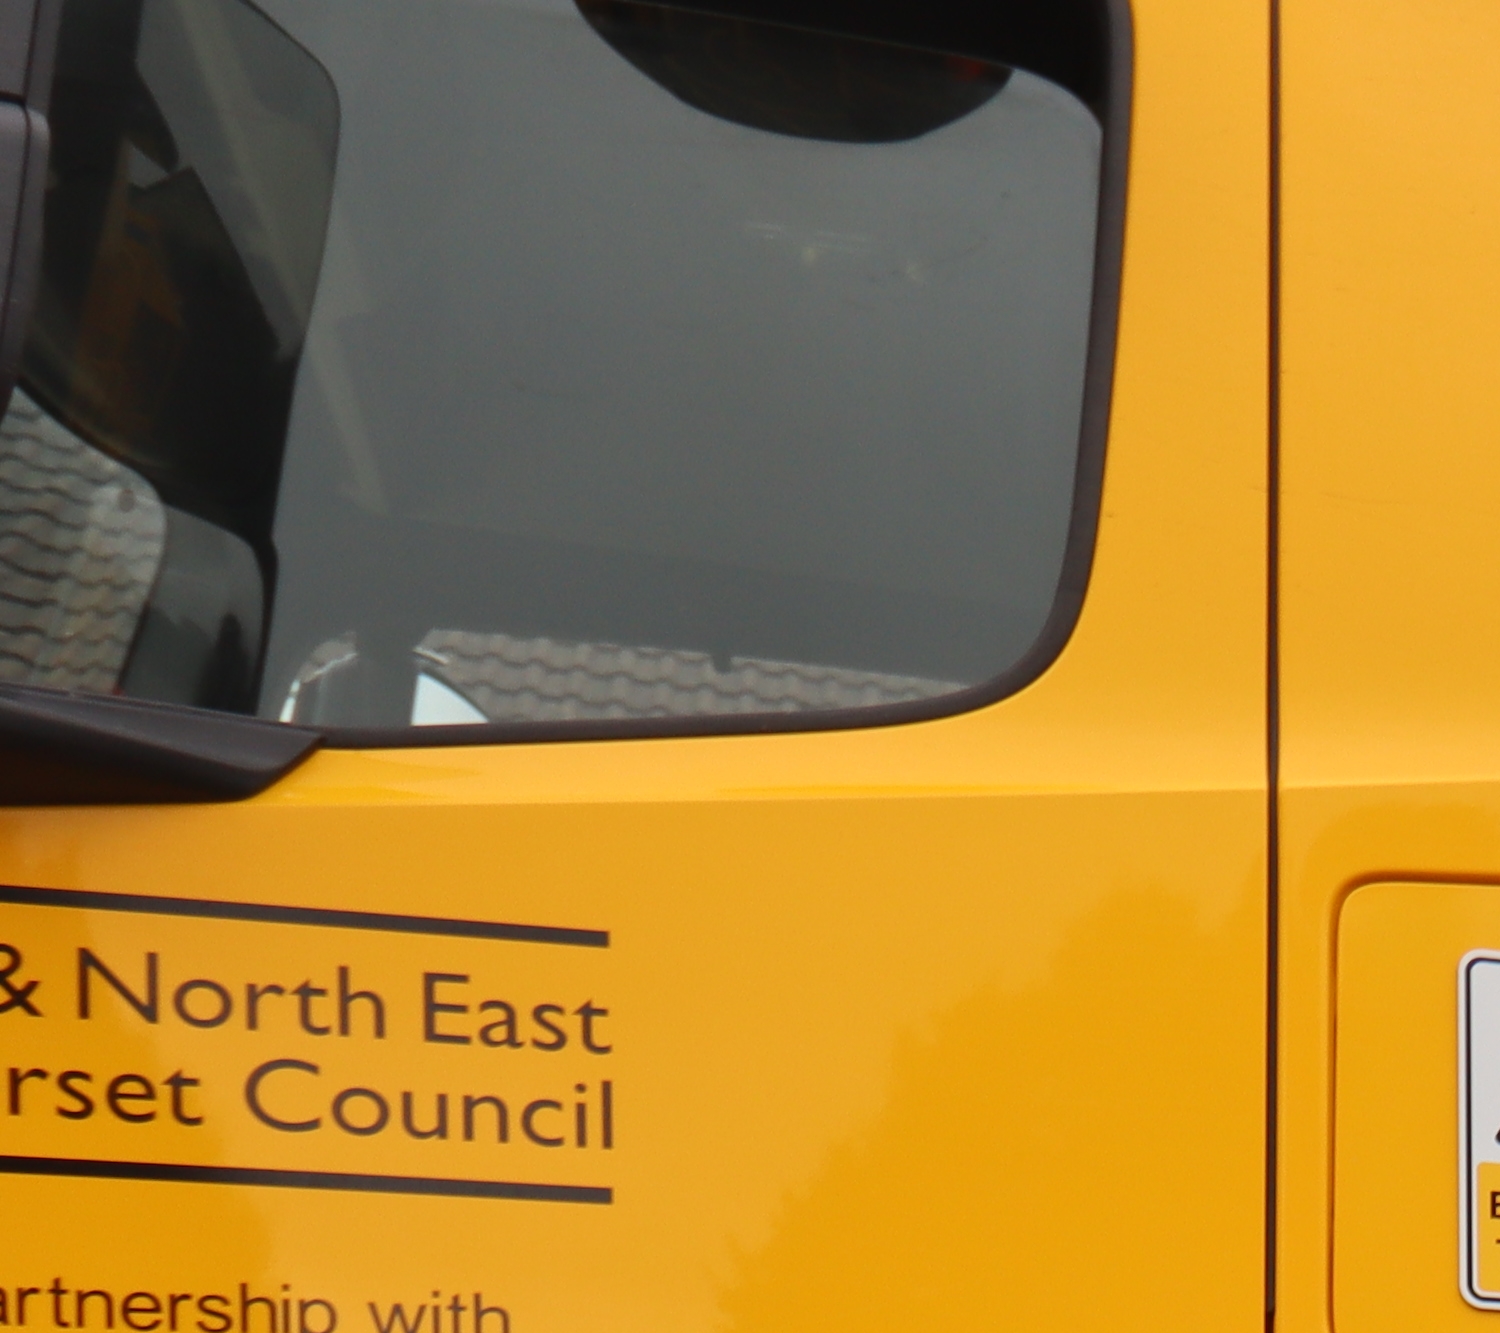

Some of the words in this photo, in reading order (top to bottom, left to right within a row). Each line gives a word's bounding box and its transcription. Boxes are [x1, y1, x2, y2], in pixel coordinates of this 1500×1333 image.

[77, 947, 385, 1040] North
[423, 972, 612, 1055] East
[245, 1058, 613, 1150] Council
